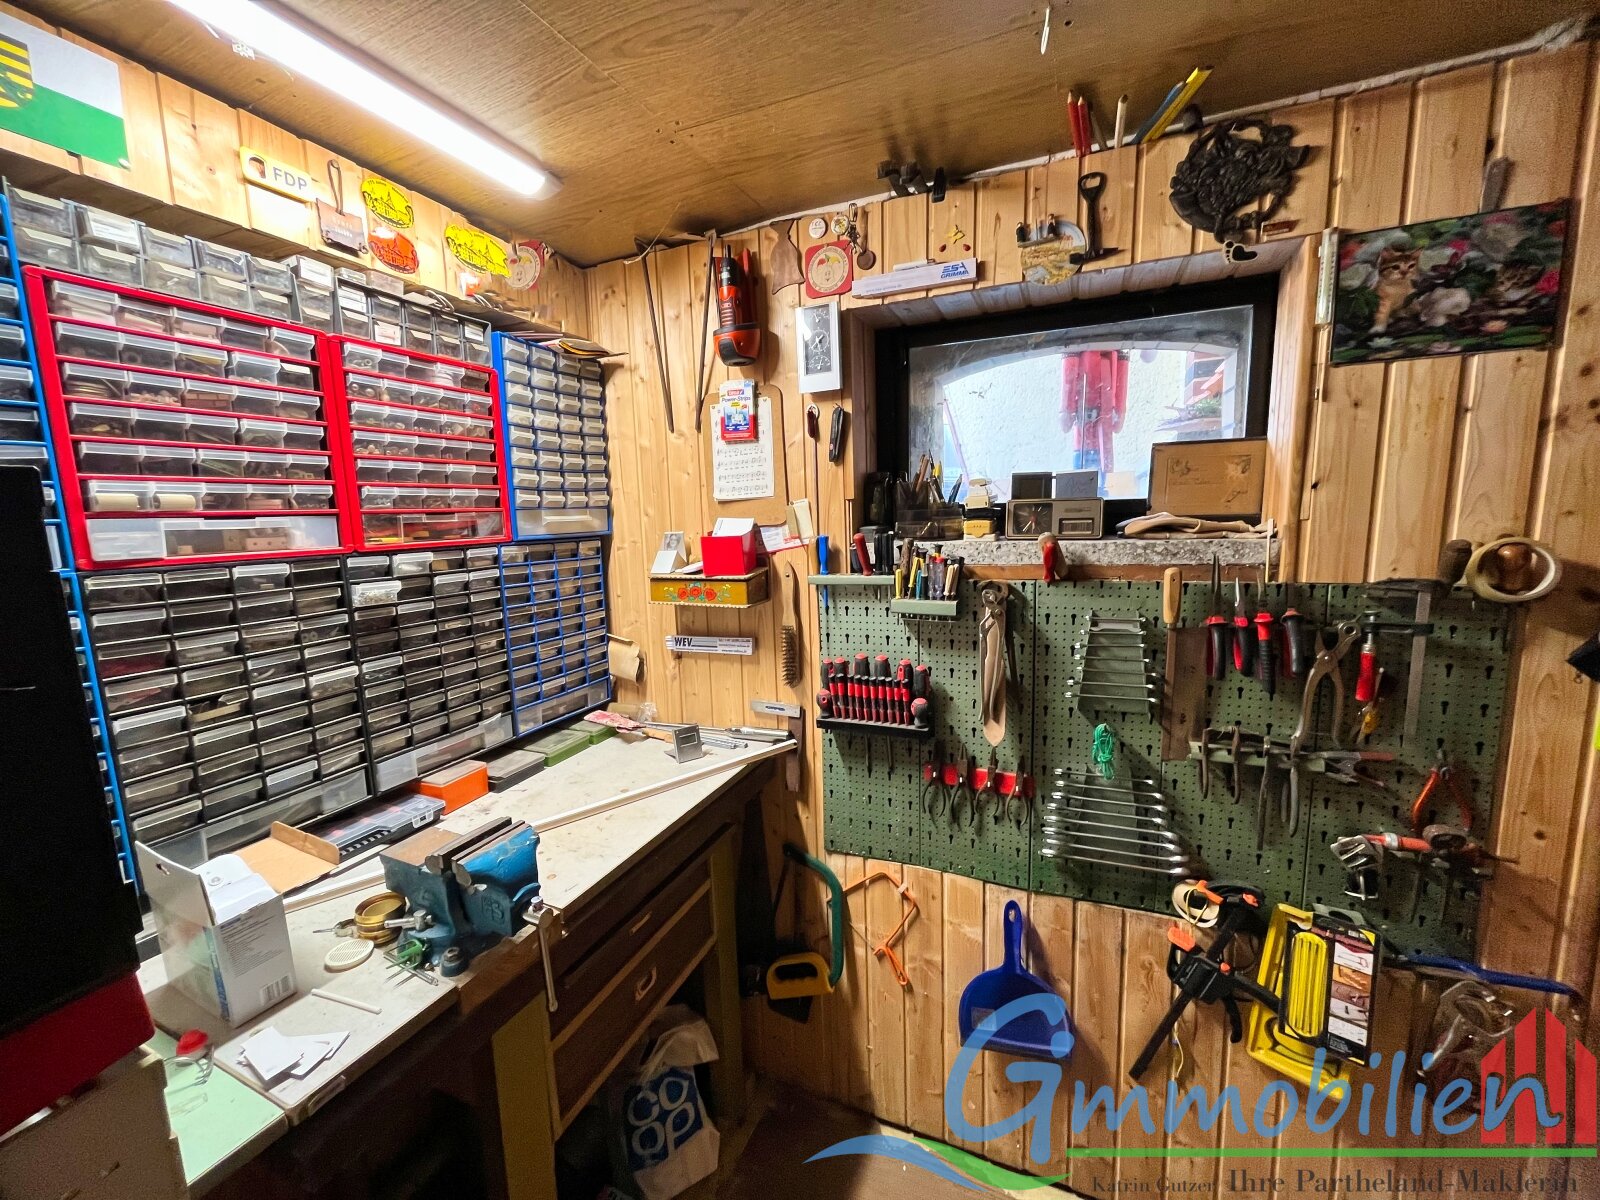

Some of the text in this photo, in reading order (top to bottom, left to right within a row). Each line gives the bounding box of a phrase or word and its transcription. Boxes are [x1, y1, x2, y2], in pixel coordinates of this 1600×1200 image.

[273, 167, 307, 190] FDP
[940, 269, 969, 279] GRIMMA
[674, 637, 693, 647] WEV
